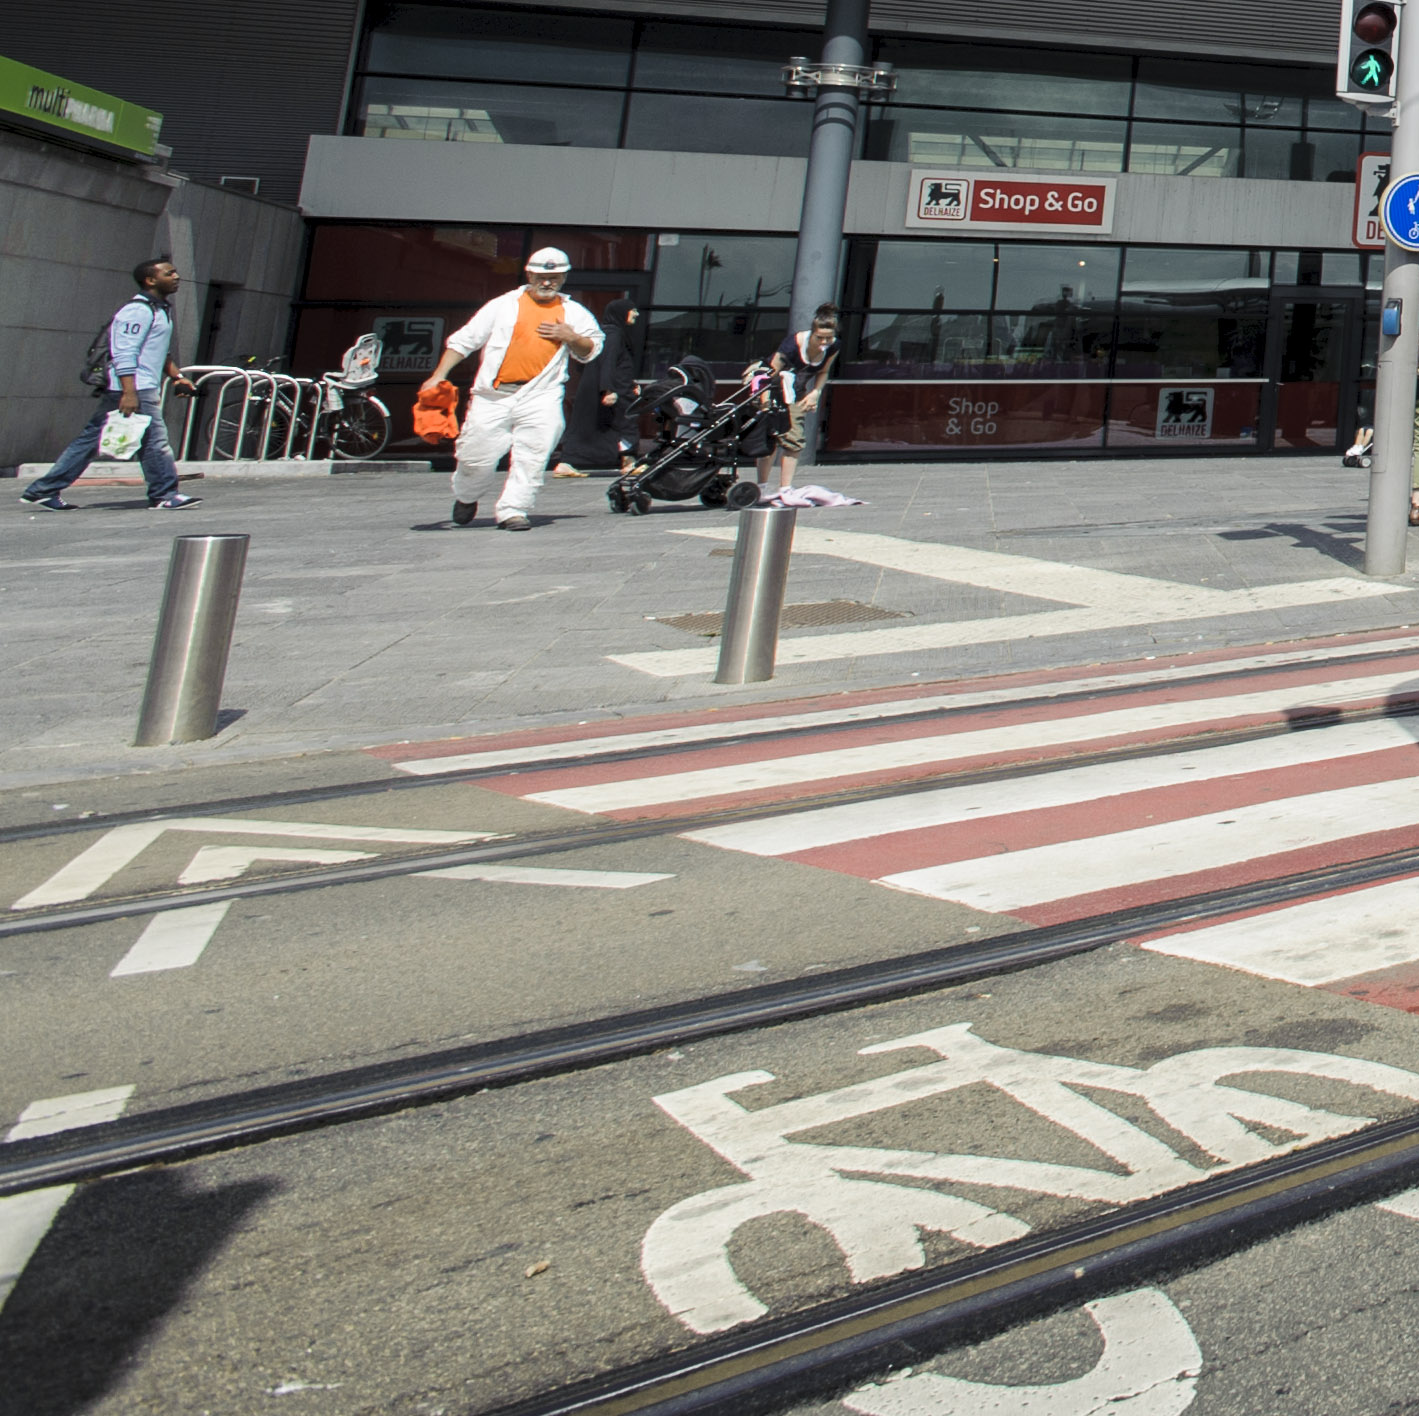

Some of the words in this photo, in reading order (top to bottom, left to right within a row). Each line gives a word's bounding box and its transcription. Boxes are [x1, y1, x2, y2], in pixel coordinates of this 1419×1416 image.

[978, 188, 1040, 216] Shop
[1044, 191, 1064, 211] &
[1067, 192, 1098, 213] Go
[923, 207, 961, 217] DELHAIZE
[123, 323, 141, 335] 10
[380, 355, 432, 369] ELHAIZE
[948, 397, 999, 417] Shop
[946, 418, 962, 434] &
[970, 418, 997, 435] Go
[1160, 424, 1207, 437] DELHAIZE
